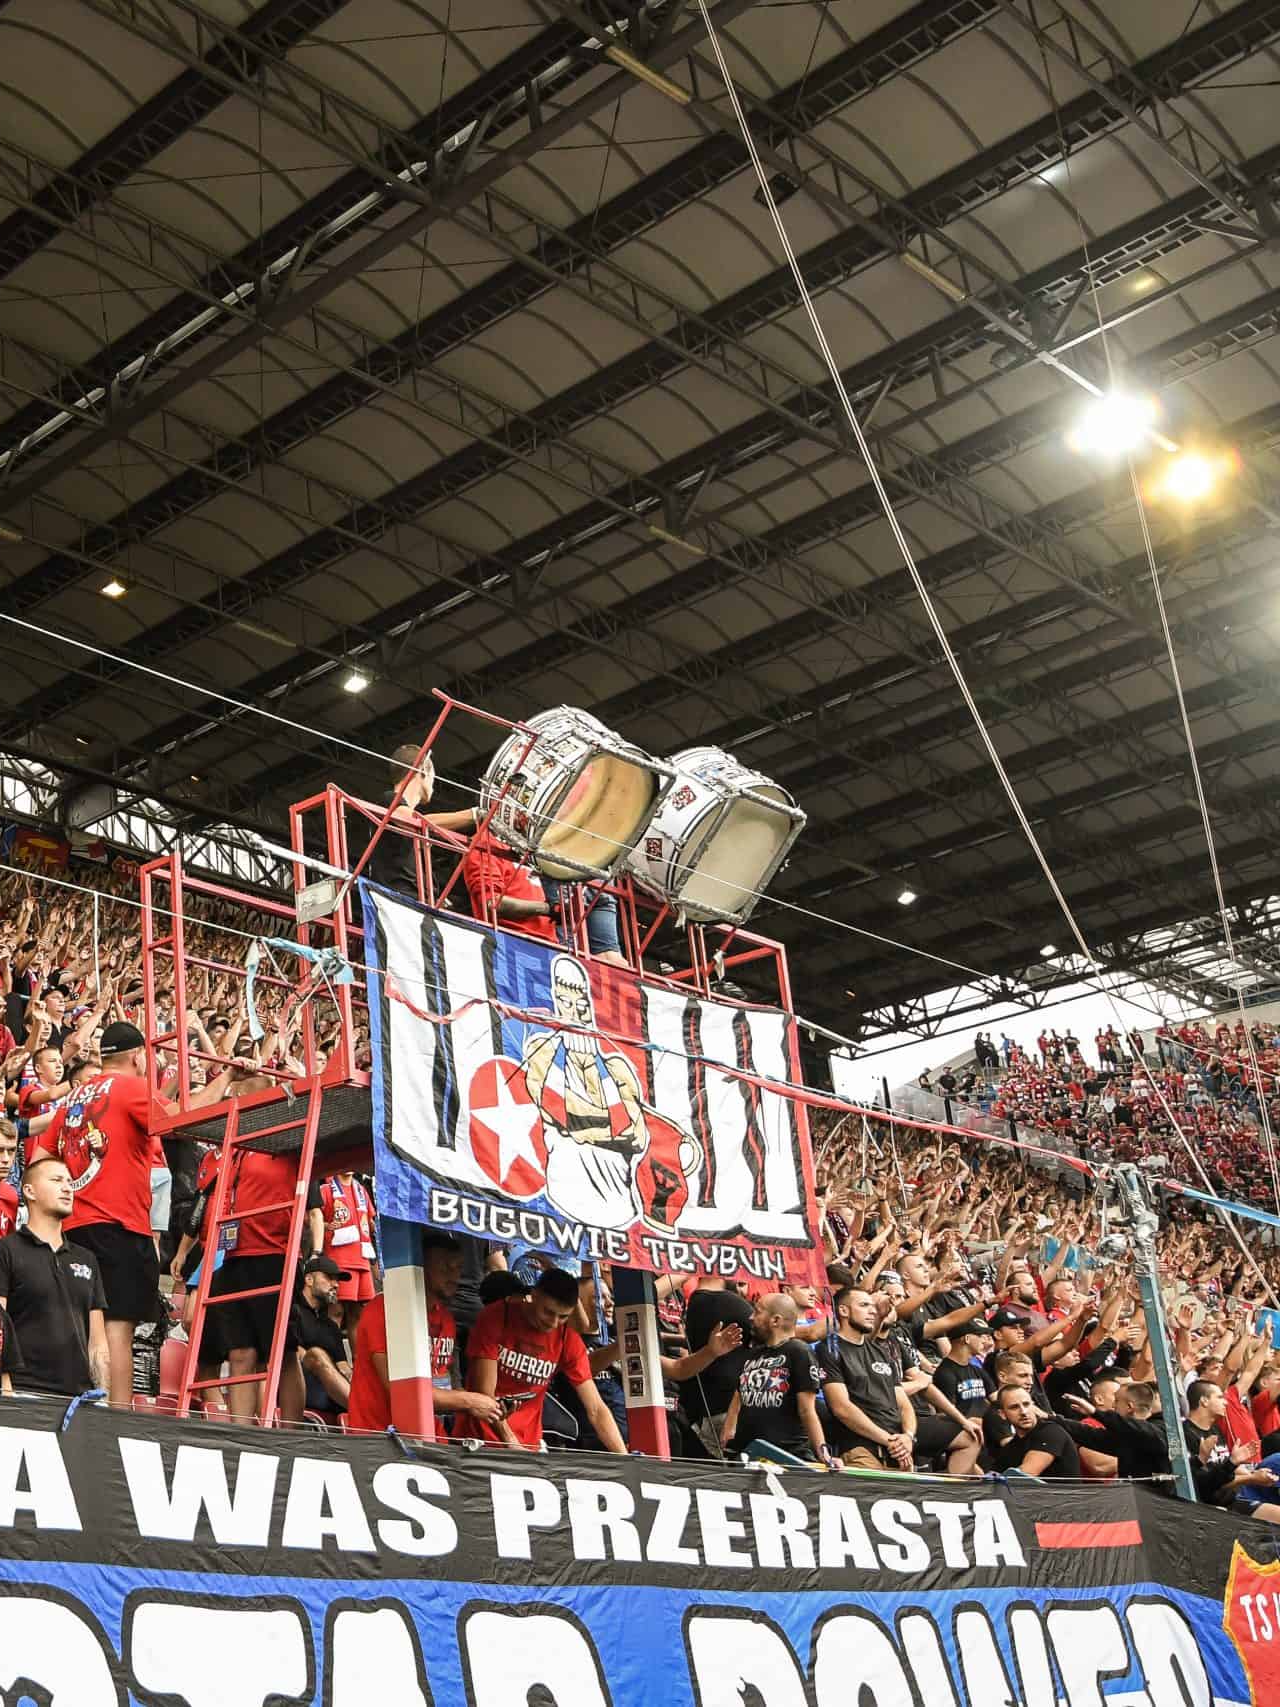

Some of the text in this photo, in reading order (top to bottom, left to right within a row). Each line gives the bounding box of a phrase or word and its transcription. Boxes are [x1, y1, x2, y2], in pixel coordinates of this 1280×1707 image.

[431, 1189, 629, 1262] BOGOWIE
[118, 1437, 458, 1557] WAS
[491, 1473, 1027, 1572] PRZERASTA
